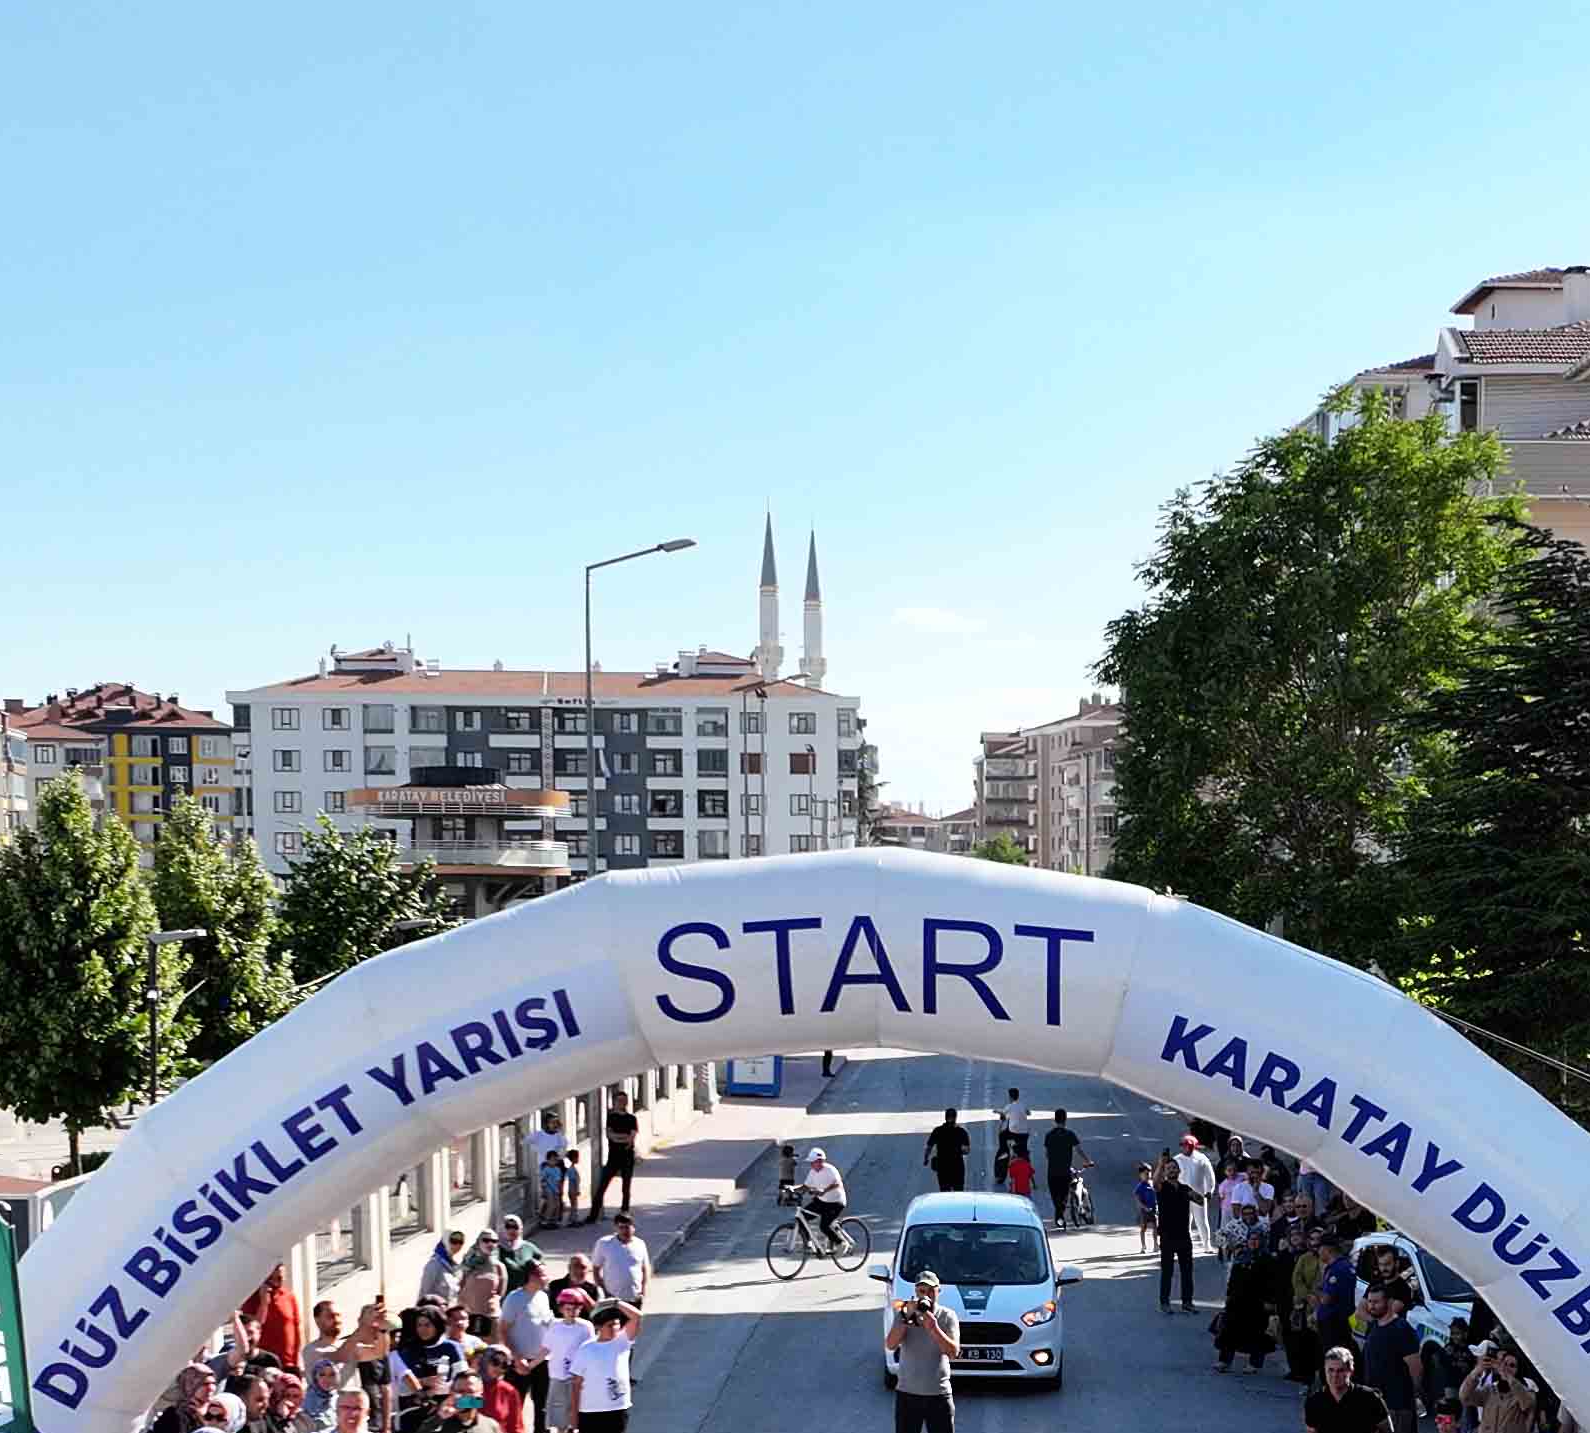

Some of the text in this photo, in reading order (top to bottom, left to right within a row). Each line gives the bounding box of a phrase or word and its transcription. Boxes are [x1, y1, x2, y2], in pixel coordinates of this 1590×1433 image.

[378, 791, 506, 803] KARATAY BELEDİYESİ
[656, 915, 1096, 1025] START
[33, 988, 582, 1409] DÜZ BİSİKLET YARIŞI
[1161, 1015, 1464, 1193] KARATAY
[1450, 1182, 1581, 1301] DÜZ
